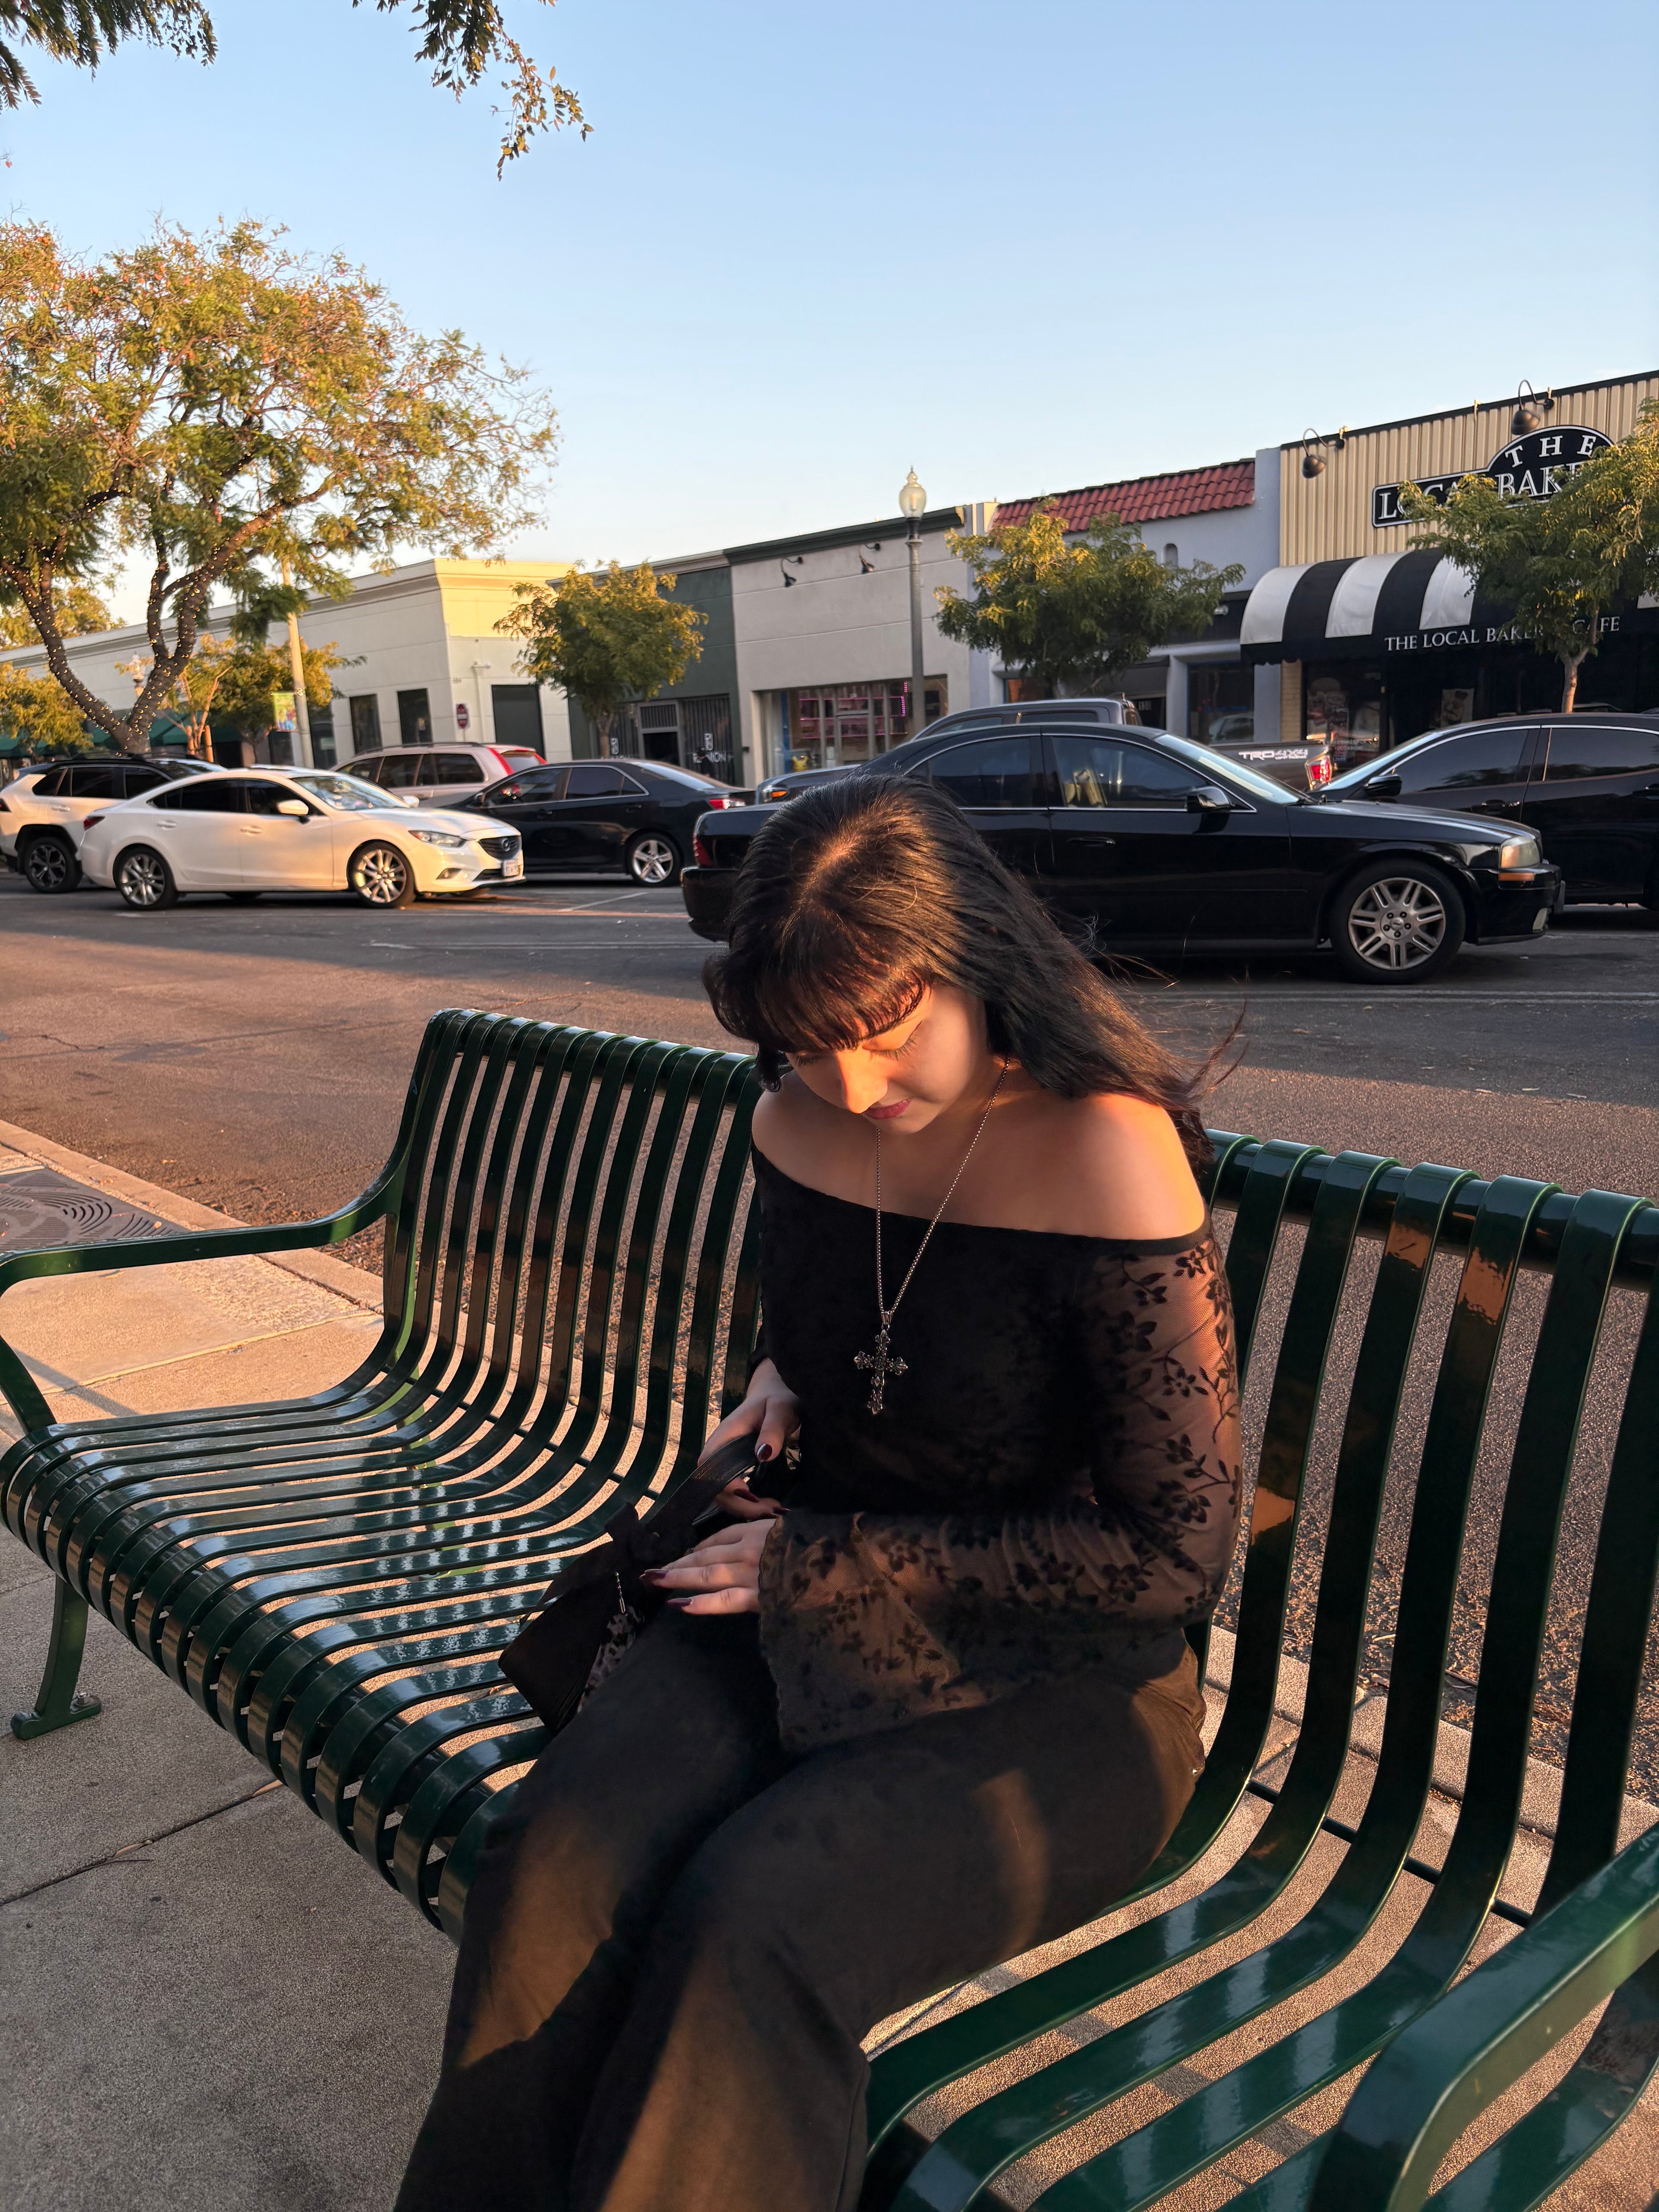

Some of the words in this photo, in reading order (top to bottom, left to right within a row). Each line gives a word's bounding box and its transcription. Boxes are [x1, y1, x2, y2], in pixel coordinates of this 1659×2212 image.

[1505, 435, 1596, 467] THE
[1384, 636, 1417, 651] THE
[1423, 629, 1479, 648] LOCAL
[1572, 617, 1620, 634] CFE
[1238, 751, 1274, 760] TRD
